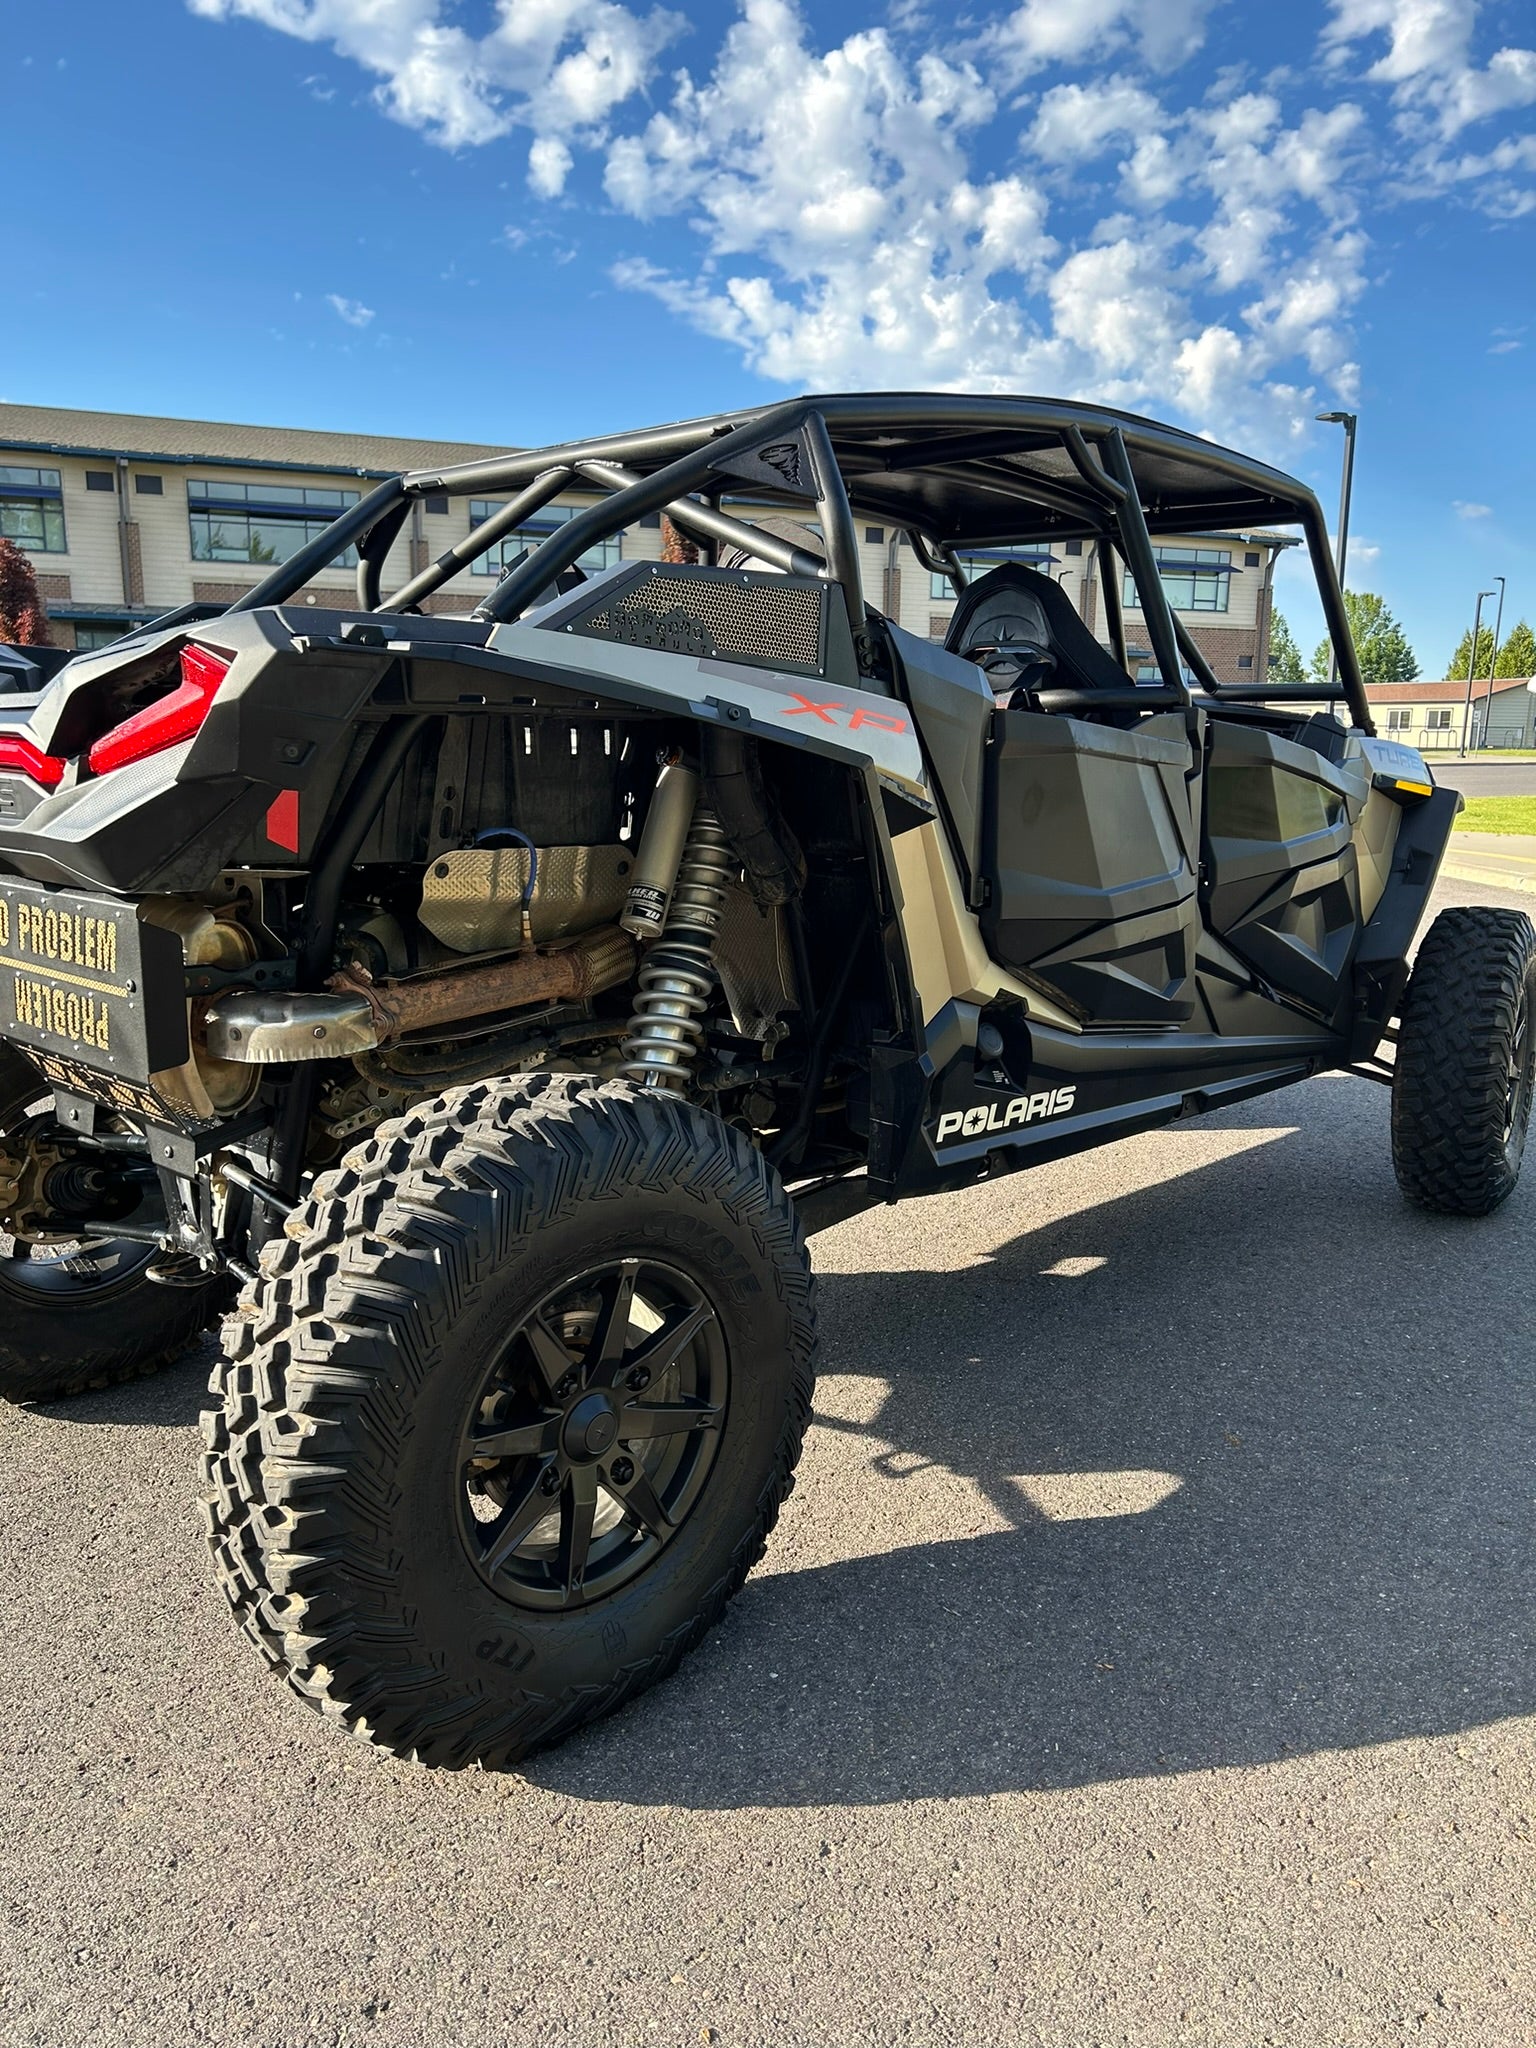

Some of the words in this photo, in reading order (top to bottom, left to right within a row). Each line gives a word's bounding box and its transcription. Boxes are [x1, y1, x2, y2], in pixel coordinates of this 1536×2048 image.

[779, 692, 907, 734] XP
[1373, 746, 1423, 769] TURB
[18, 903, 117, 973] PROBLEM
[14, 977, 109, 1051] PROBLEM
[936, 1085, 1077, 1143] POLARIS
[642, 1209, 762, 1305] COYOTE
[475, 1634, 536, 1673] ITP
